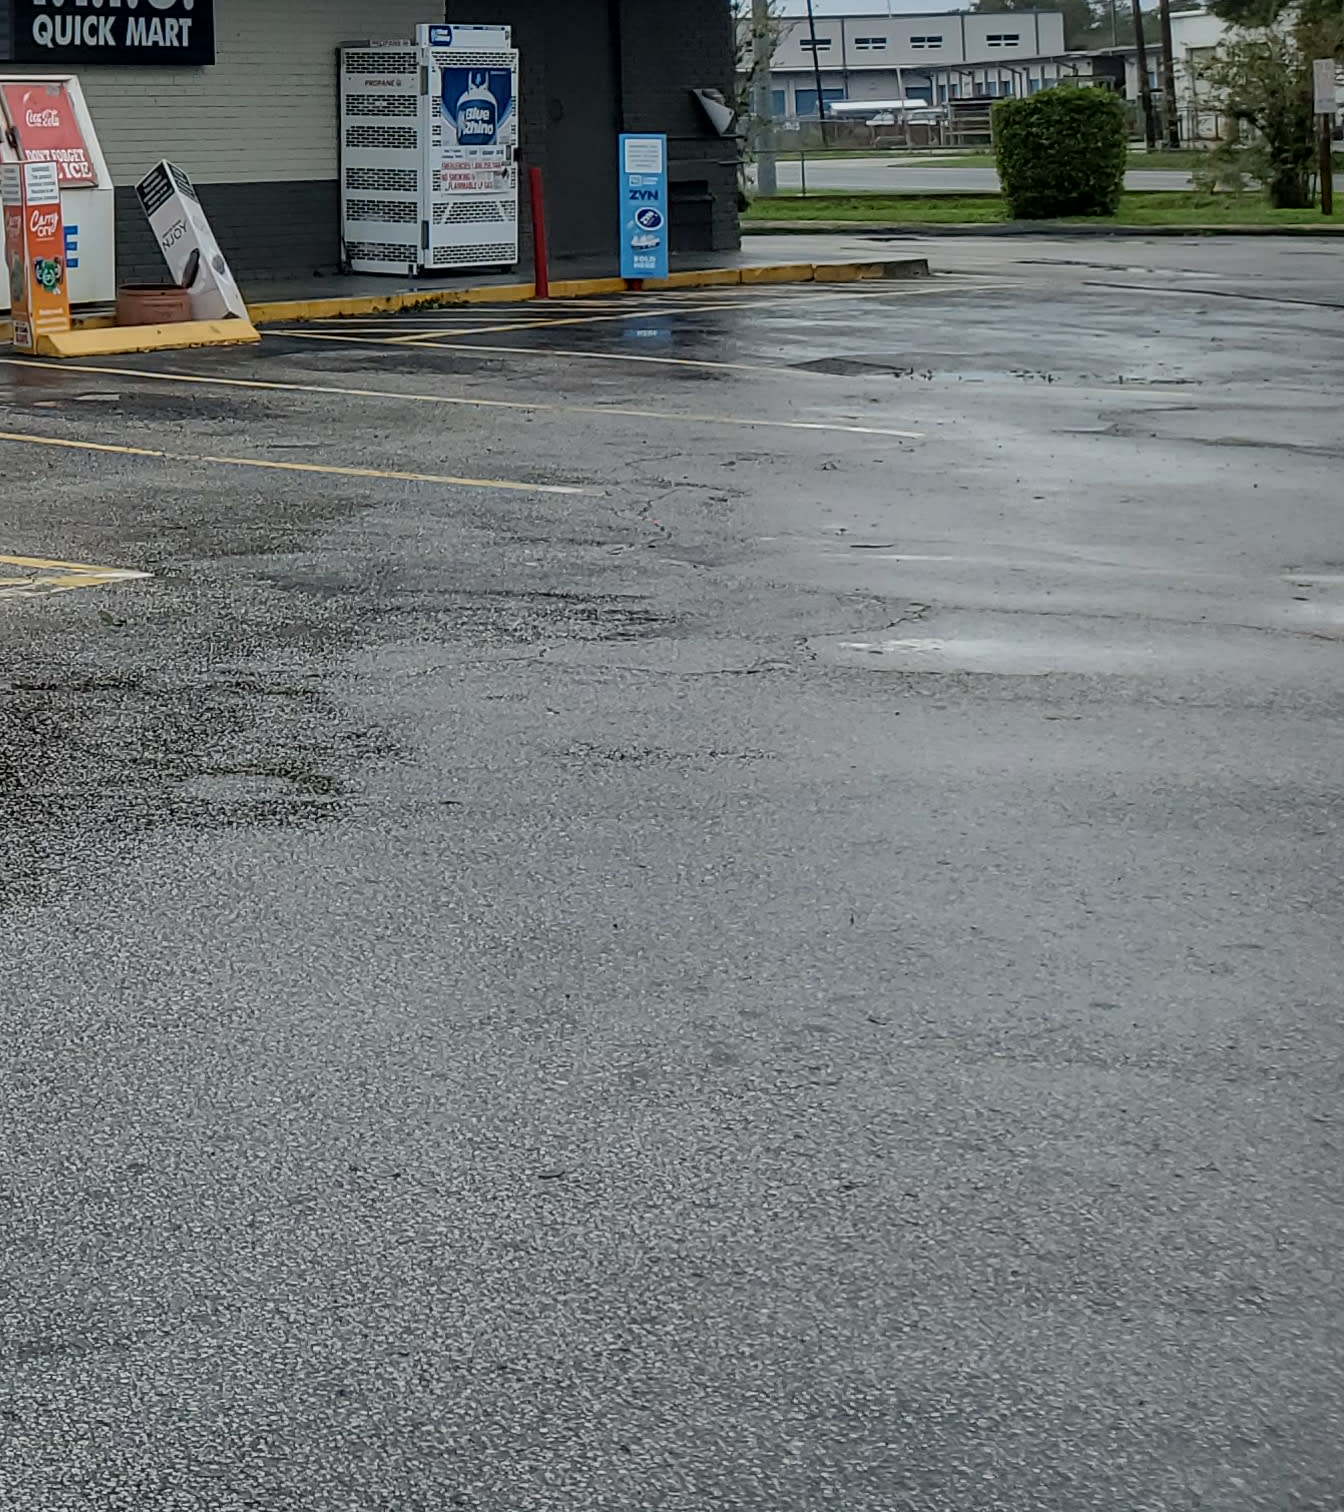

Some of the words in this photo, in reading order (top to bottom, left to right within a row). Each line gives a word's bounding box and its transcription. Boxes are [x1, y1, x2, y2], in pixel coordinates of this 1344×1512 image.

[32, 13, 116, 48] QUICK
[125, 16, 193, 47] MART
[465, 107, 490, 121] Blue
[51, 148, 86, 162] FORGET
[64, 161, 92, 179] ICE
[629, 189, 659, 201] ZYN
